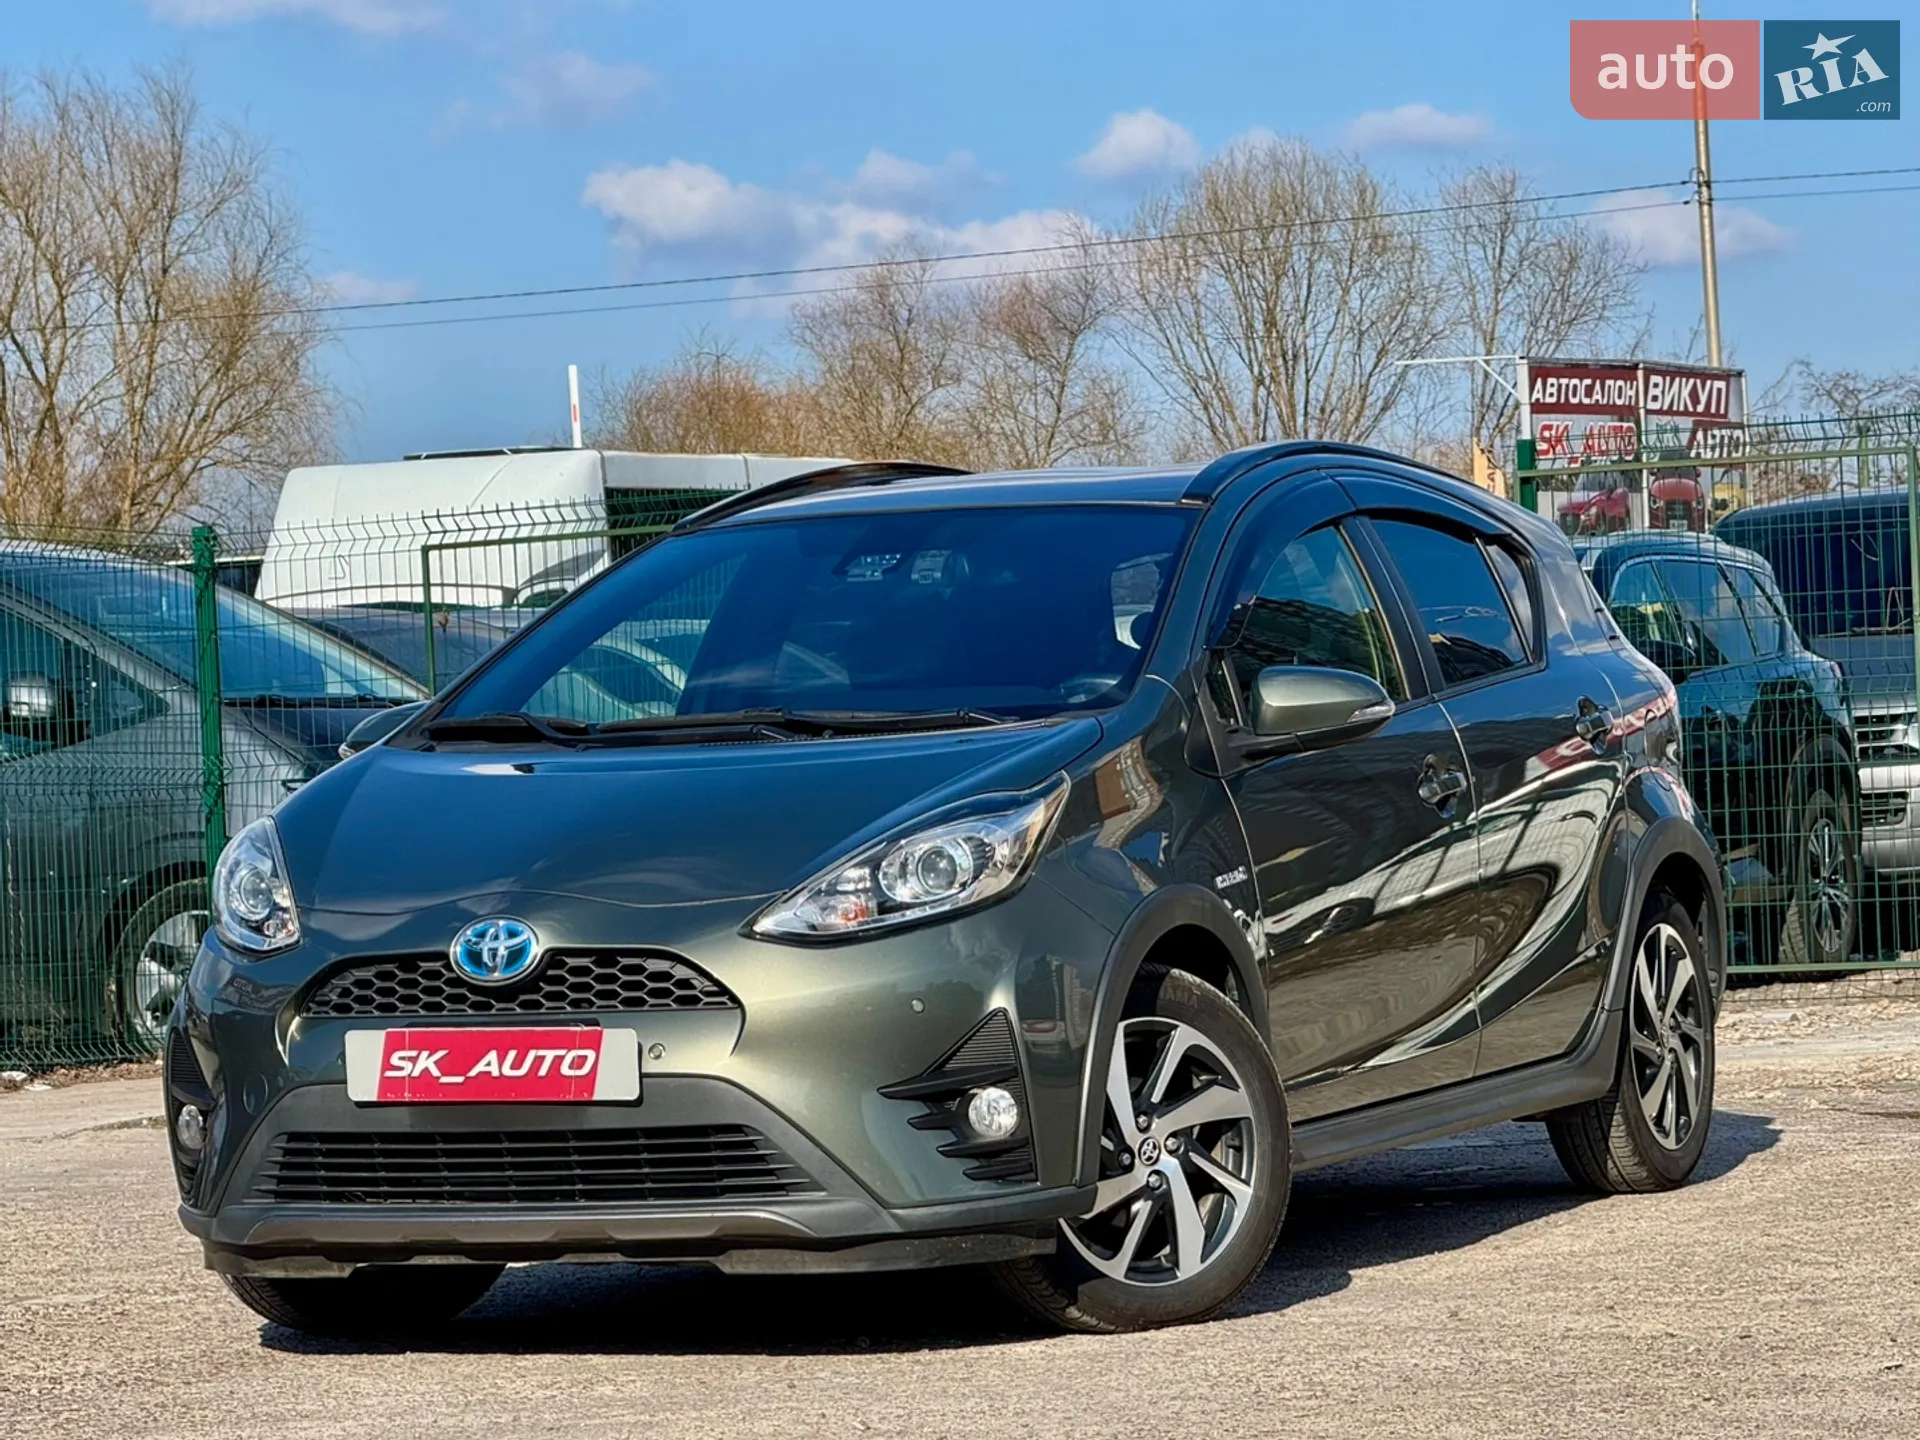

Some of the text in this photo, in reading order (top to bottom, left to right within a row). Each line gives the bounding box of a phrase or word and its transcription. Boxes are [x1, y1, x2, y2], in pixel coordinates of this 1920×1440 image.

[1531, 377, 1638, 407] АВТОСАЛОН
[1646, 375, 1727, 415] ВИКУП
[1690, 427, 1744, 459] АВТО
[383, 1049, 596, 1084] SK_AUTO
